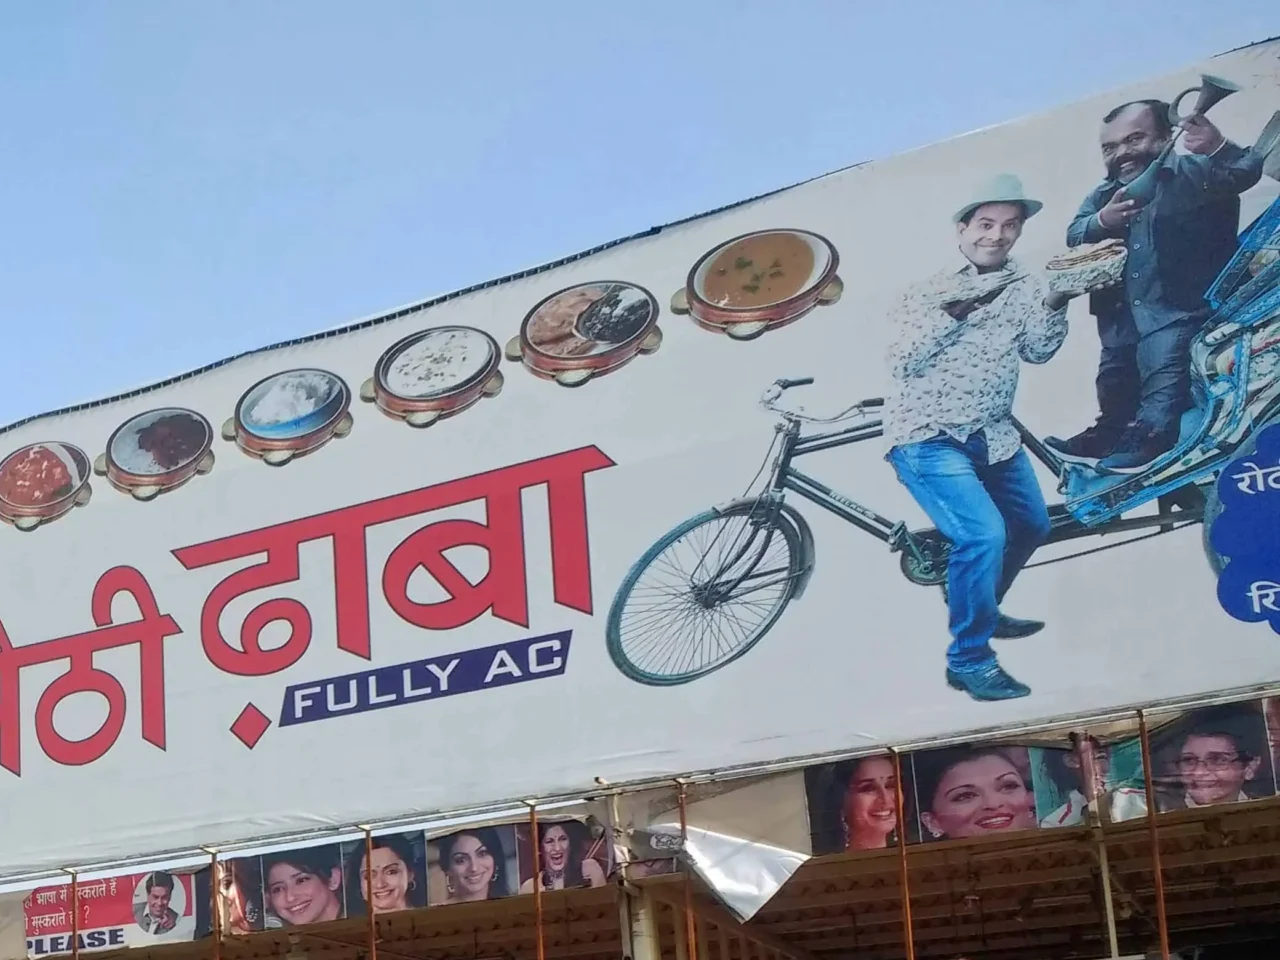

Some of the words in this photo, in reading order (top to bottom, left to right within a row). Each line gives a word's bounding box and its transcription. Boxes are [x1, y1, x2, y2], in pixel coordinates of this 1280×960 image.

[293, 658, 472, 719] FULLY
[483, 637, 564, 685] AC
[36, 890, 56, 906] भाषा
[60, 885, 68, 902] में
